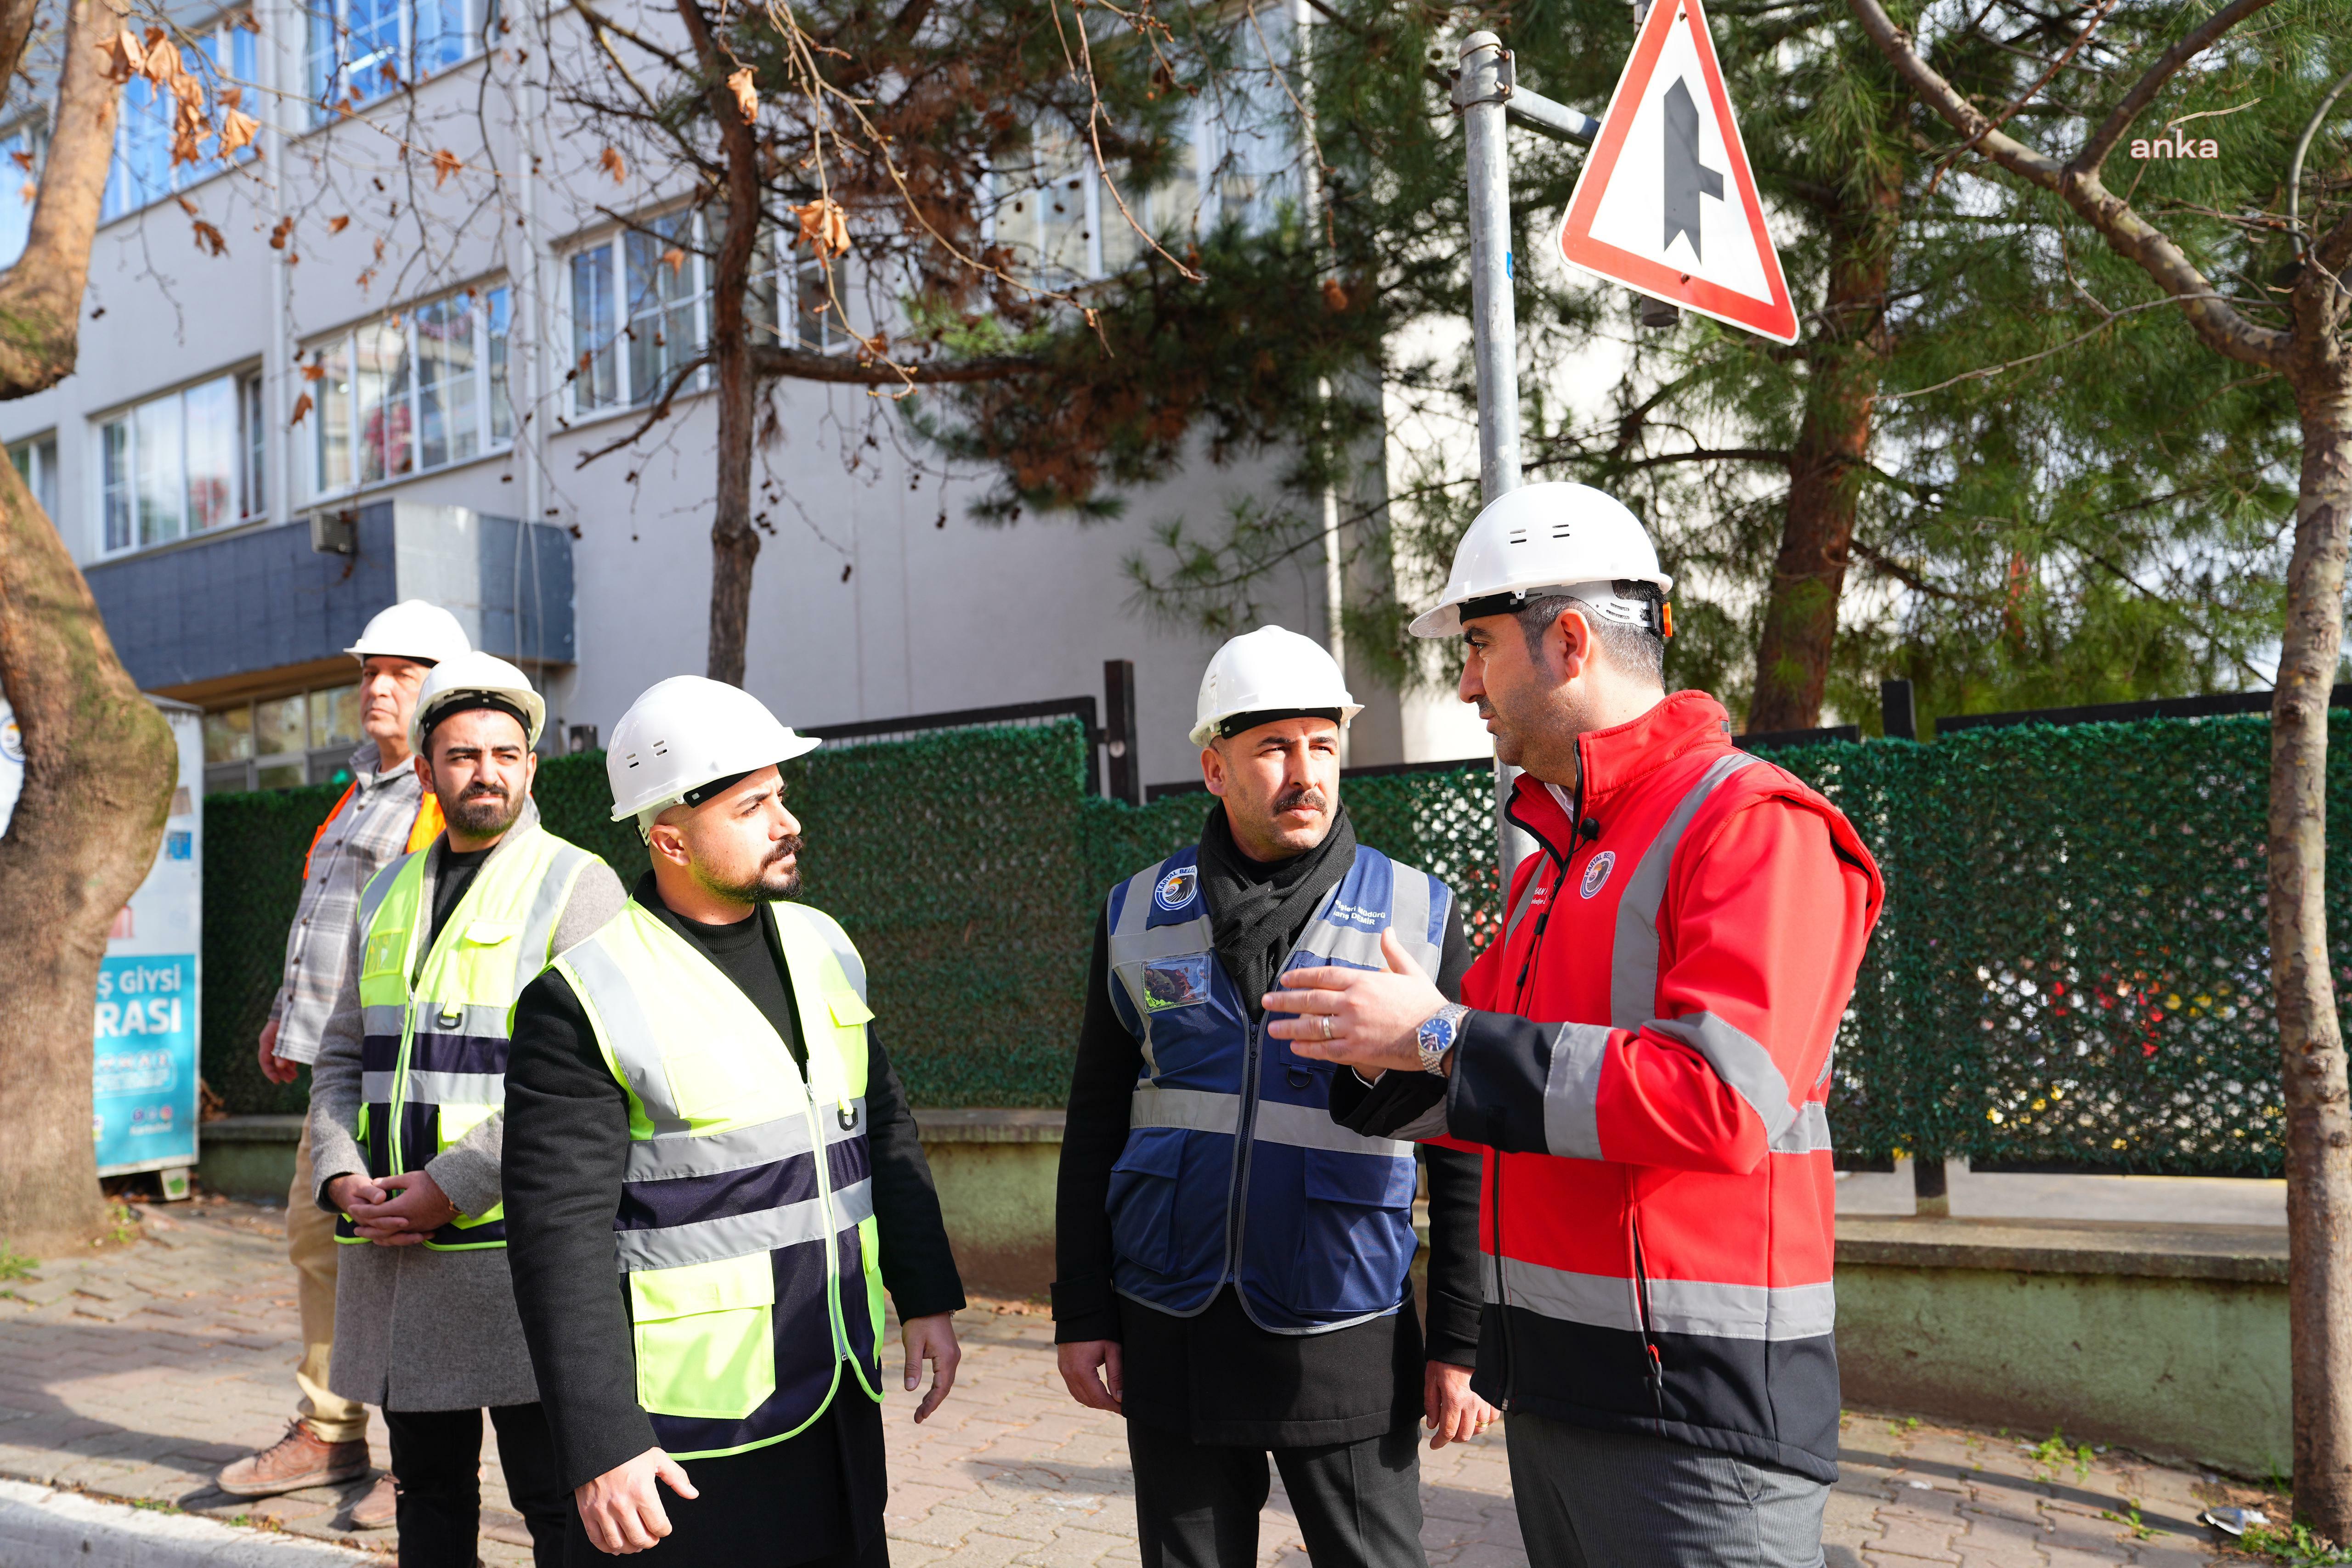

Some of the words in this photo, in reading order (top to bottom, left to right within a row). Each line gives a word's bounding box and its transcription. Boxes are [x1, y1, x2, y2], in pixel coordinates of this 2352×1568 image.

[1585, 855, 1602, 876] KARTAL
[1157, 872, 1177, 891] KARTAL
[1351, 913, 1375, 925] DEMİR
[119, 964, 181, 994] GİYSİ
